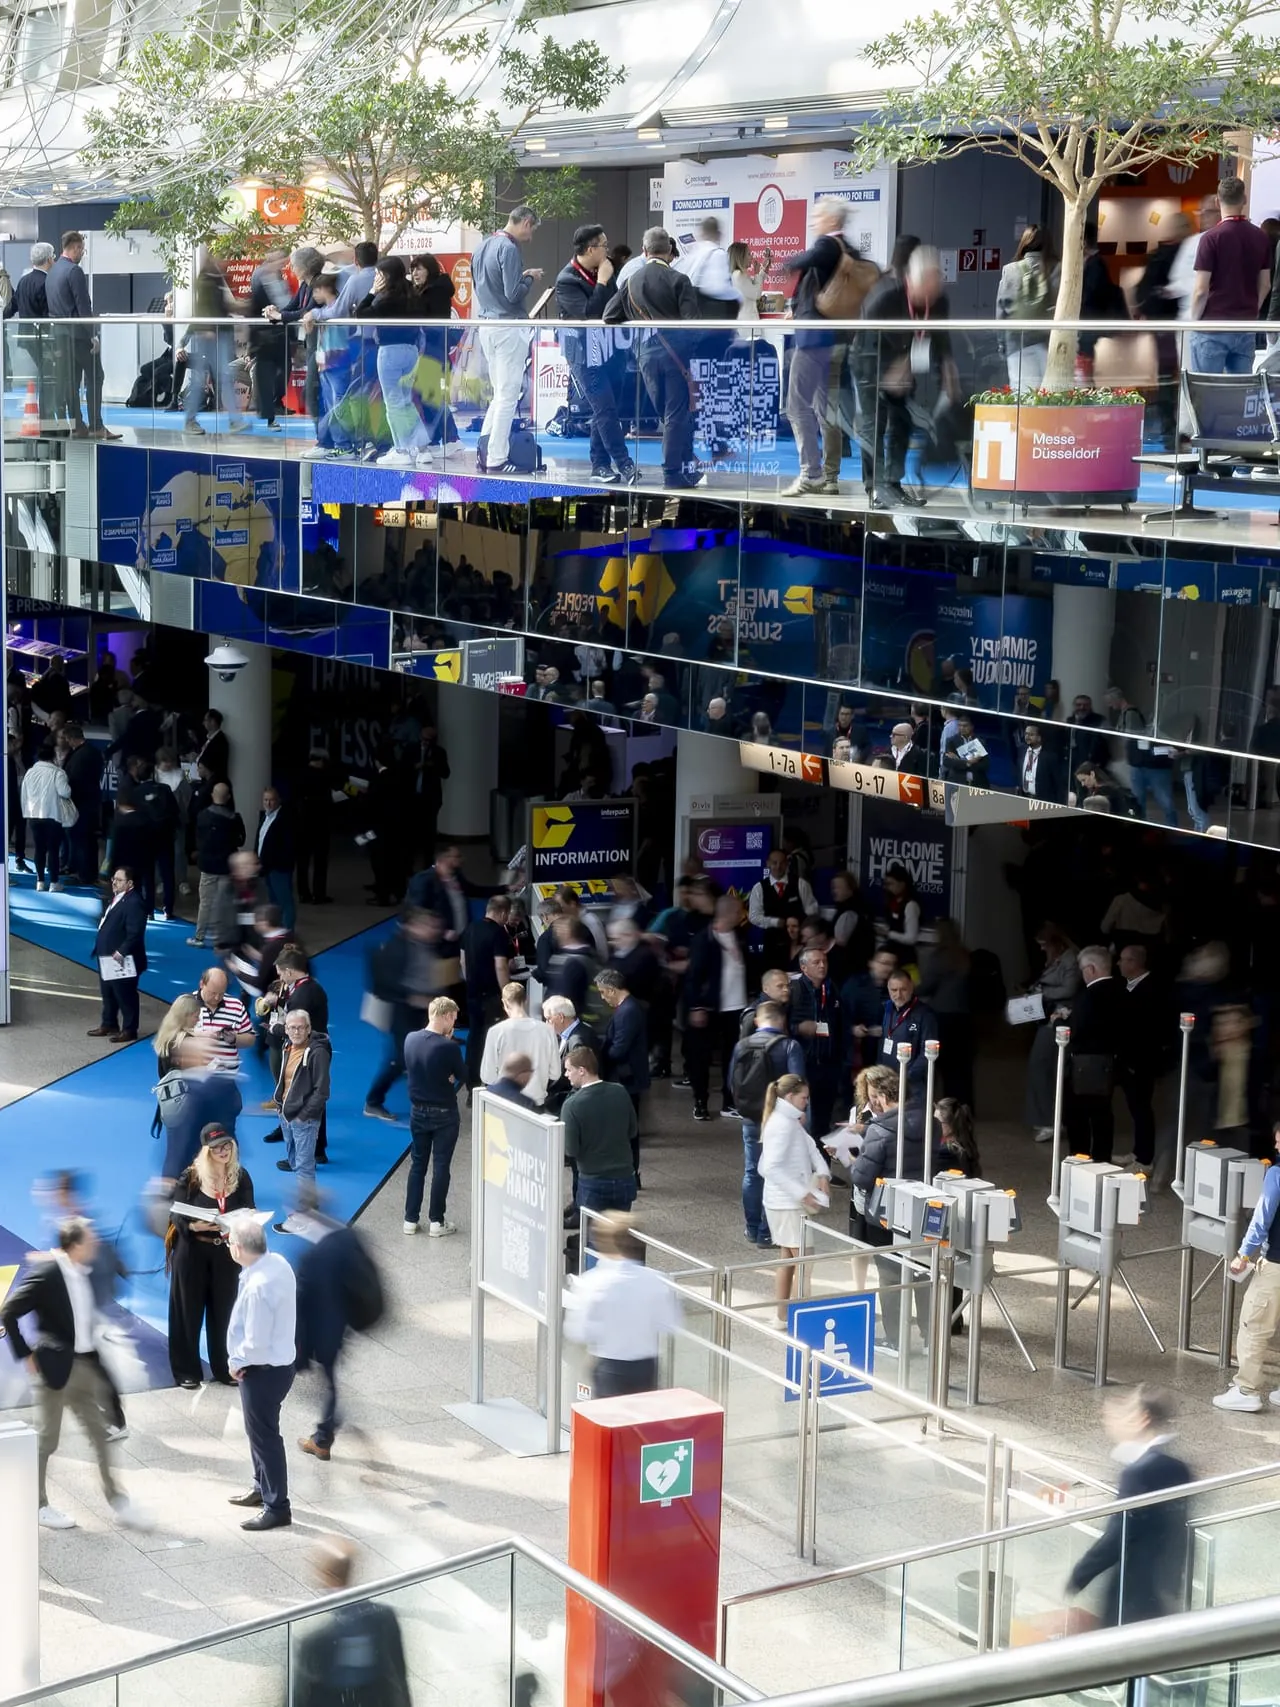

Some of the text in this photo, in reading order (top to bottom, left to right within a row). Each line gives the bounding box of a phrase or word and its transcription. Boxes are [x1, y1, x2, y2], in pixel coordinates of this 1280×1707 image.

[675, 199, 723, 210] DOWNLOAD FOR FREE
[773, 237, 784, 246] FOR
[784, 236, 800, 245] FOOD
[1033, 433, 1076, 445] Messe
[1032, 447, 1100, 459] Düsseldorf
[600, 808, 630, 817] interpack
[869, 837, 945, 862] WELCOME
[535, 849, 630, 866] INFORMATION
[916, 882, 944, 894] 2026
[506, 1144, 547, 1185] SIMPLY
[506, 1172, 546, 1212] HANDY
